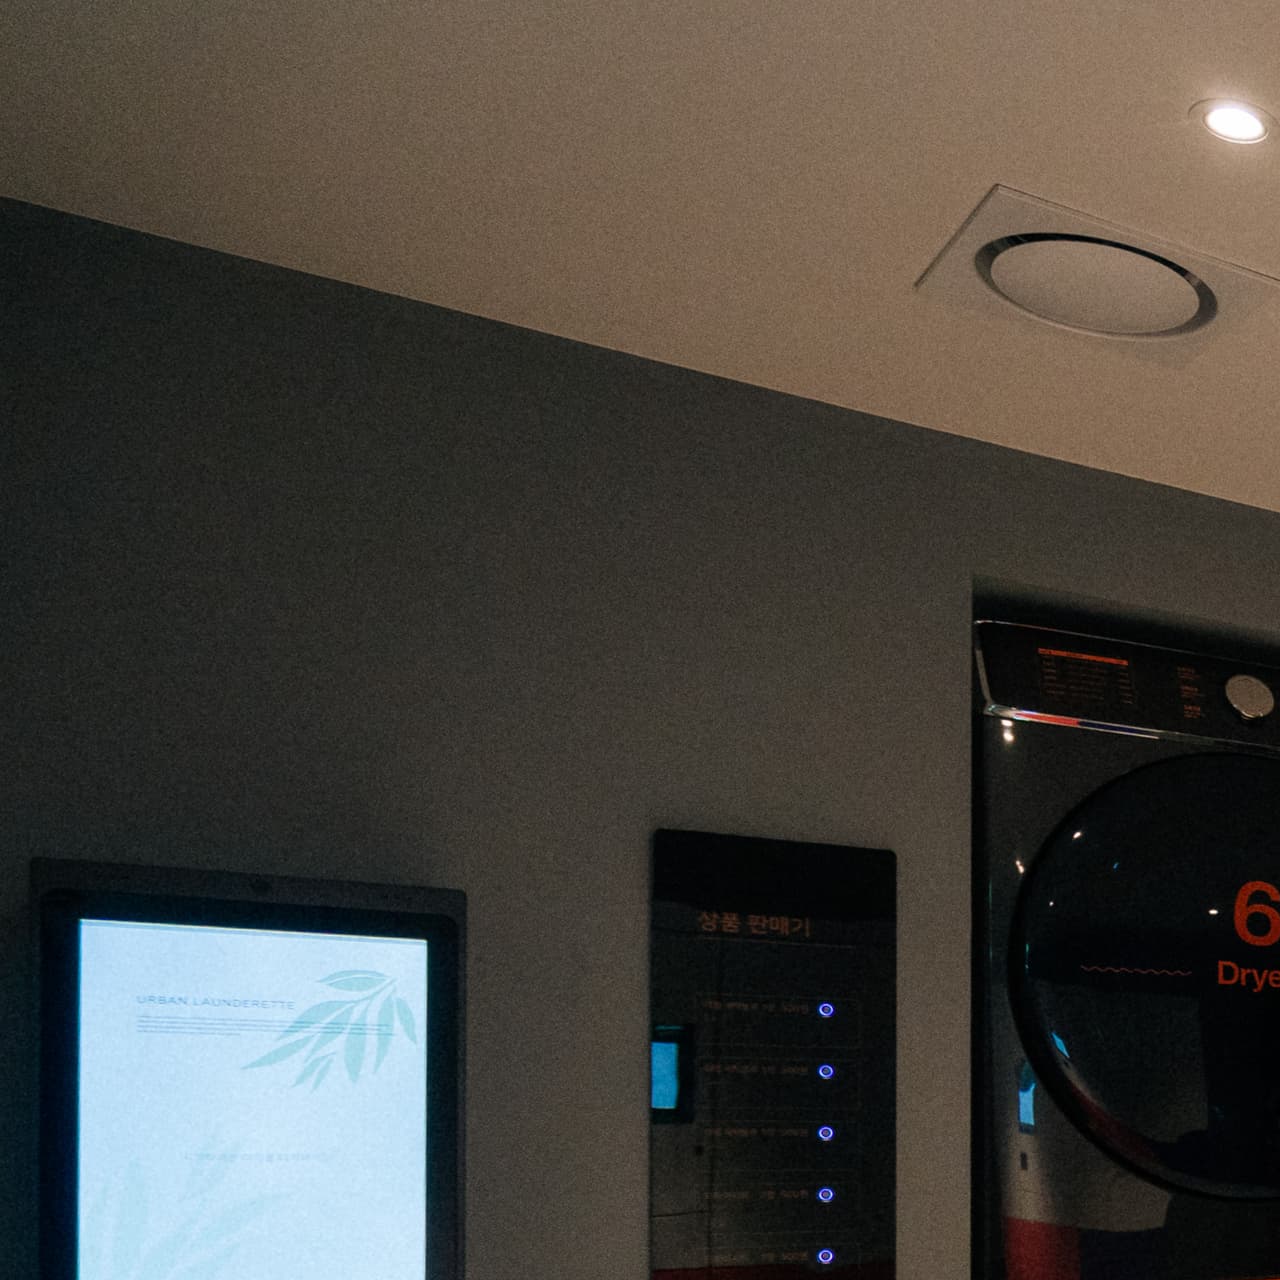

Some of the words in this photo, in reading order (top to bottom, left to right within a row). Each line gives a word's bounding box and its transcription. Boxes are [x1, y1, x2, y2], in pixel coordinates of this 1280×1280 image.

[698, 911, 741, 933] 상품
[136, 994, 188, 1005] URBAN
[193, 997, 296, 1010] LAUNDERETTE
